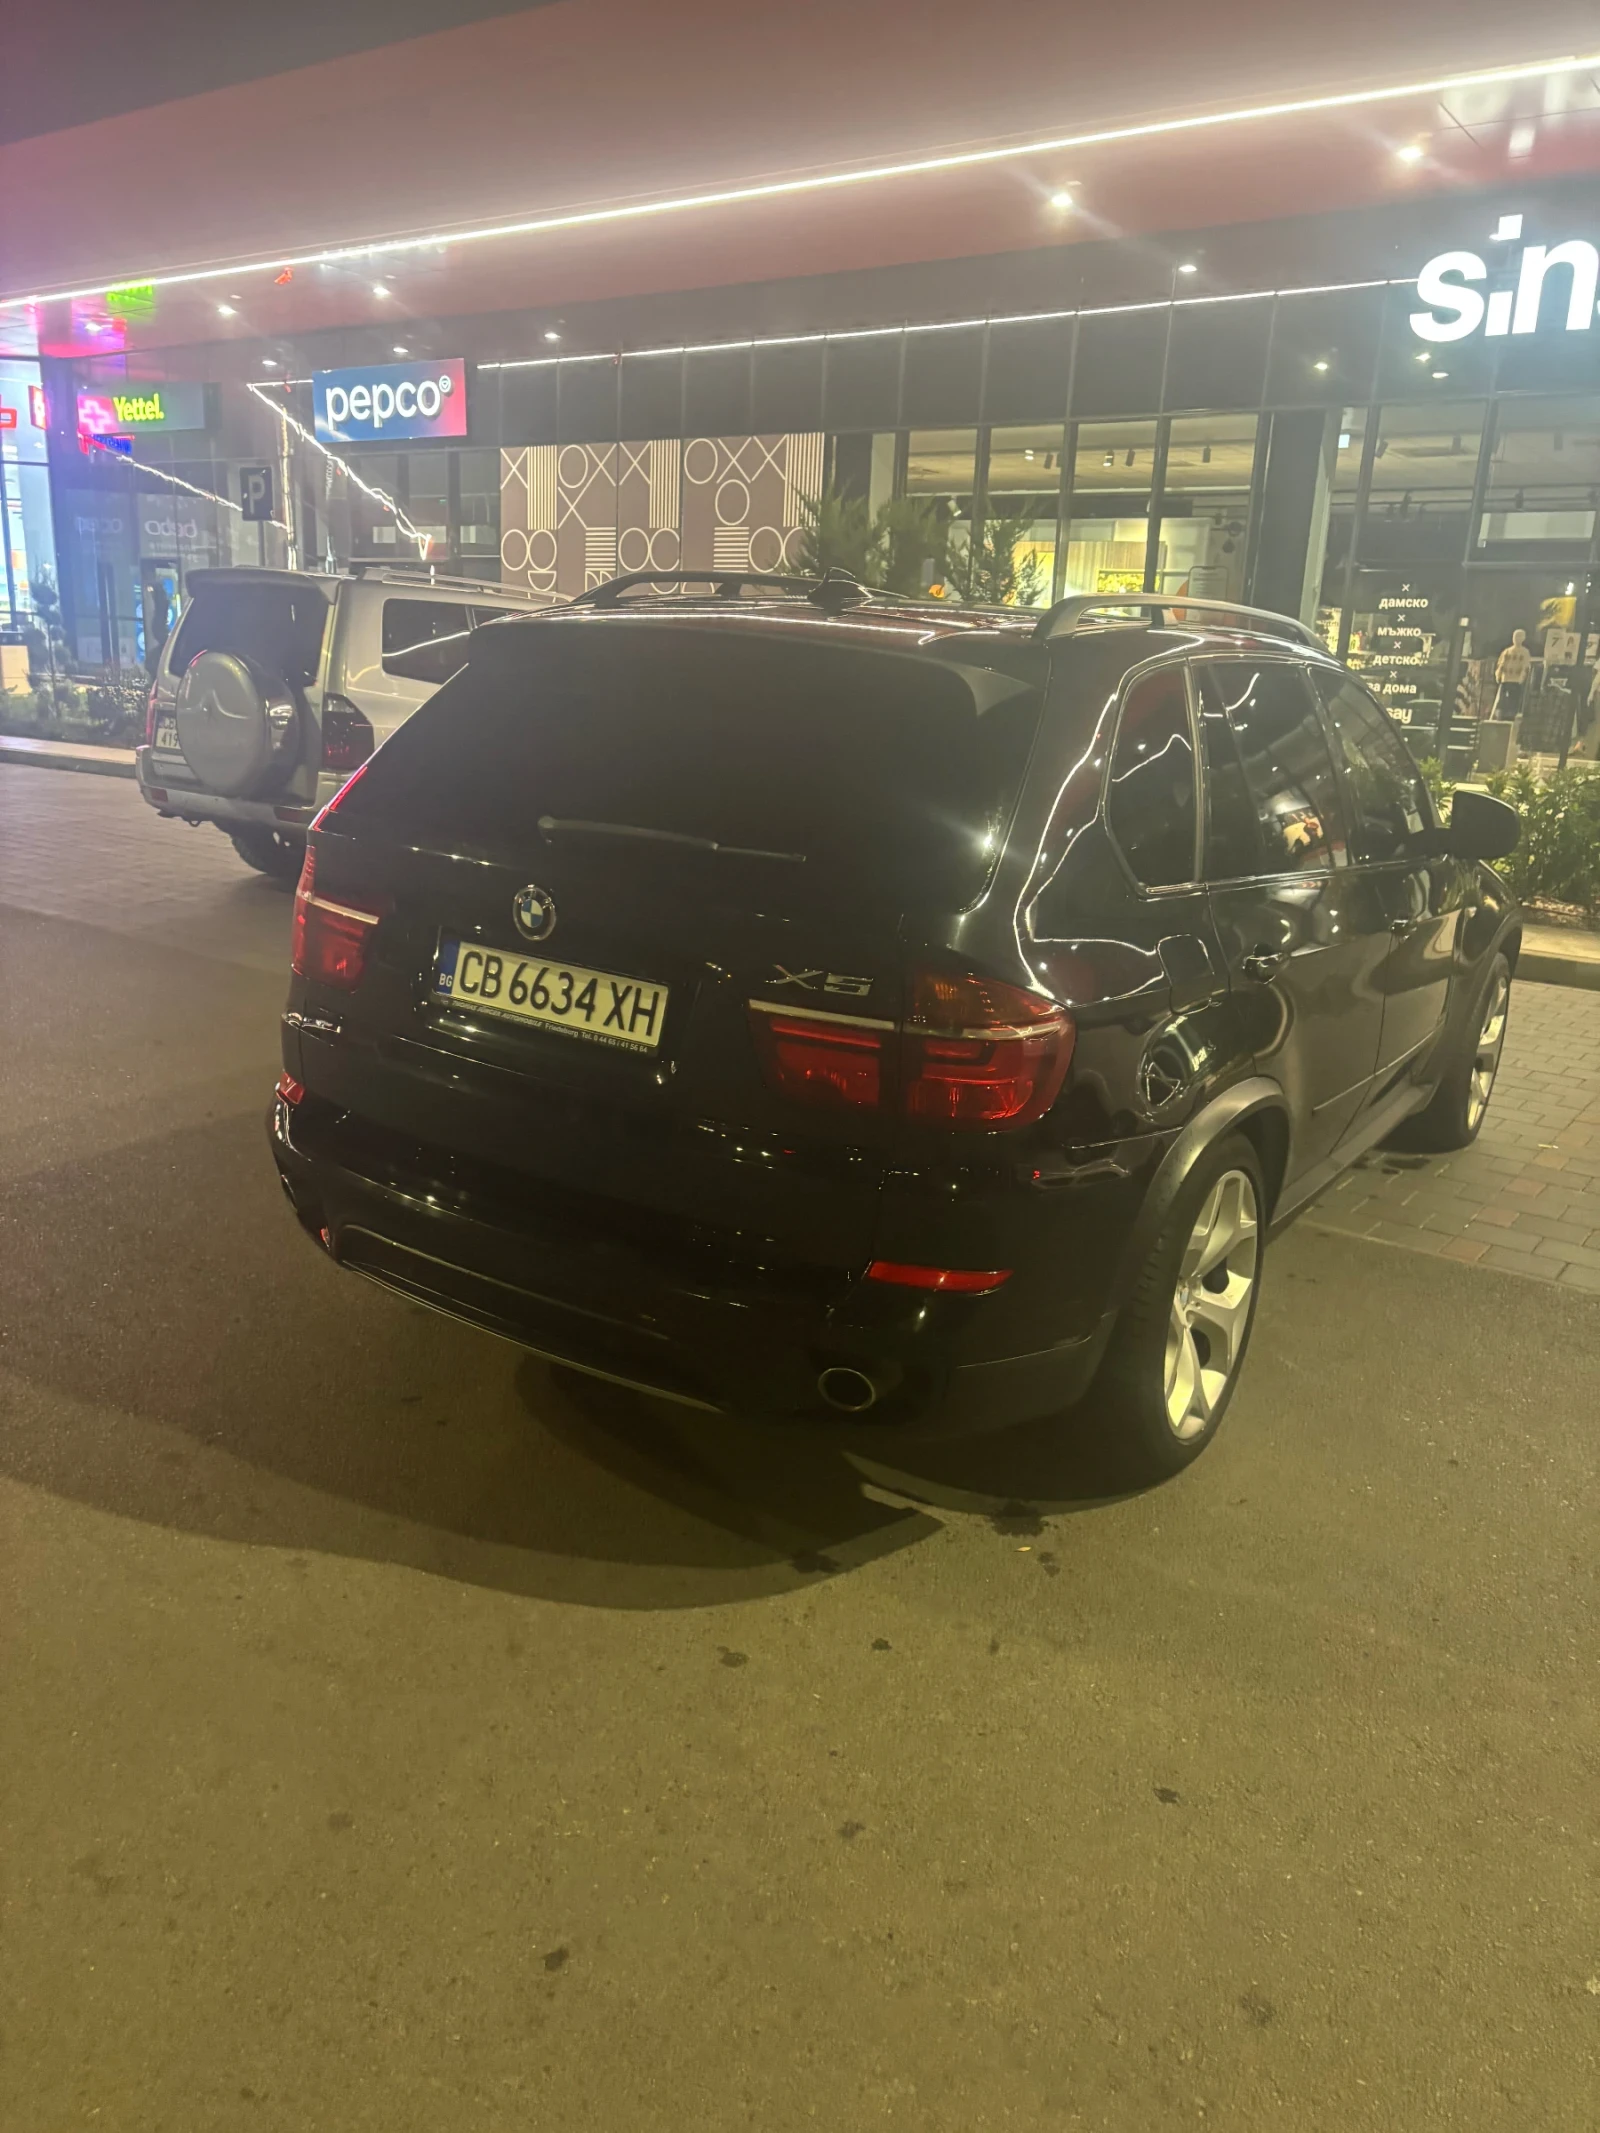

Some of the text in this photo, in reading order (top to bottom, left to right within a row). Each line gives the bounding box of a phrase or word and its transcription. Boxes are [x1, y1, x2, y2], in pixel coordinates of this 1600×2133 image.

[1410, 214, 1600, 342] sin
[326, 380, 441, 431] pepco
[248, 474, 265, 514] P
[1378, 597, 1429, 610] дамско
[1377, 626, 1422, 637] мъжко
[1372, 654, 1418, 666] детско
[1382, 682, 1417, 694] дома
[439, 973, 453, 988] BG
[459, 951, 660, 1037] CB 6634 XH
